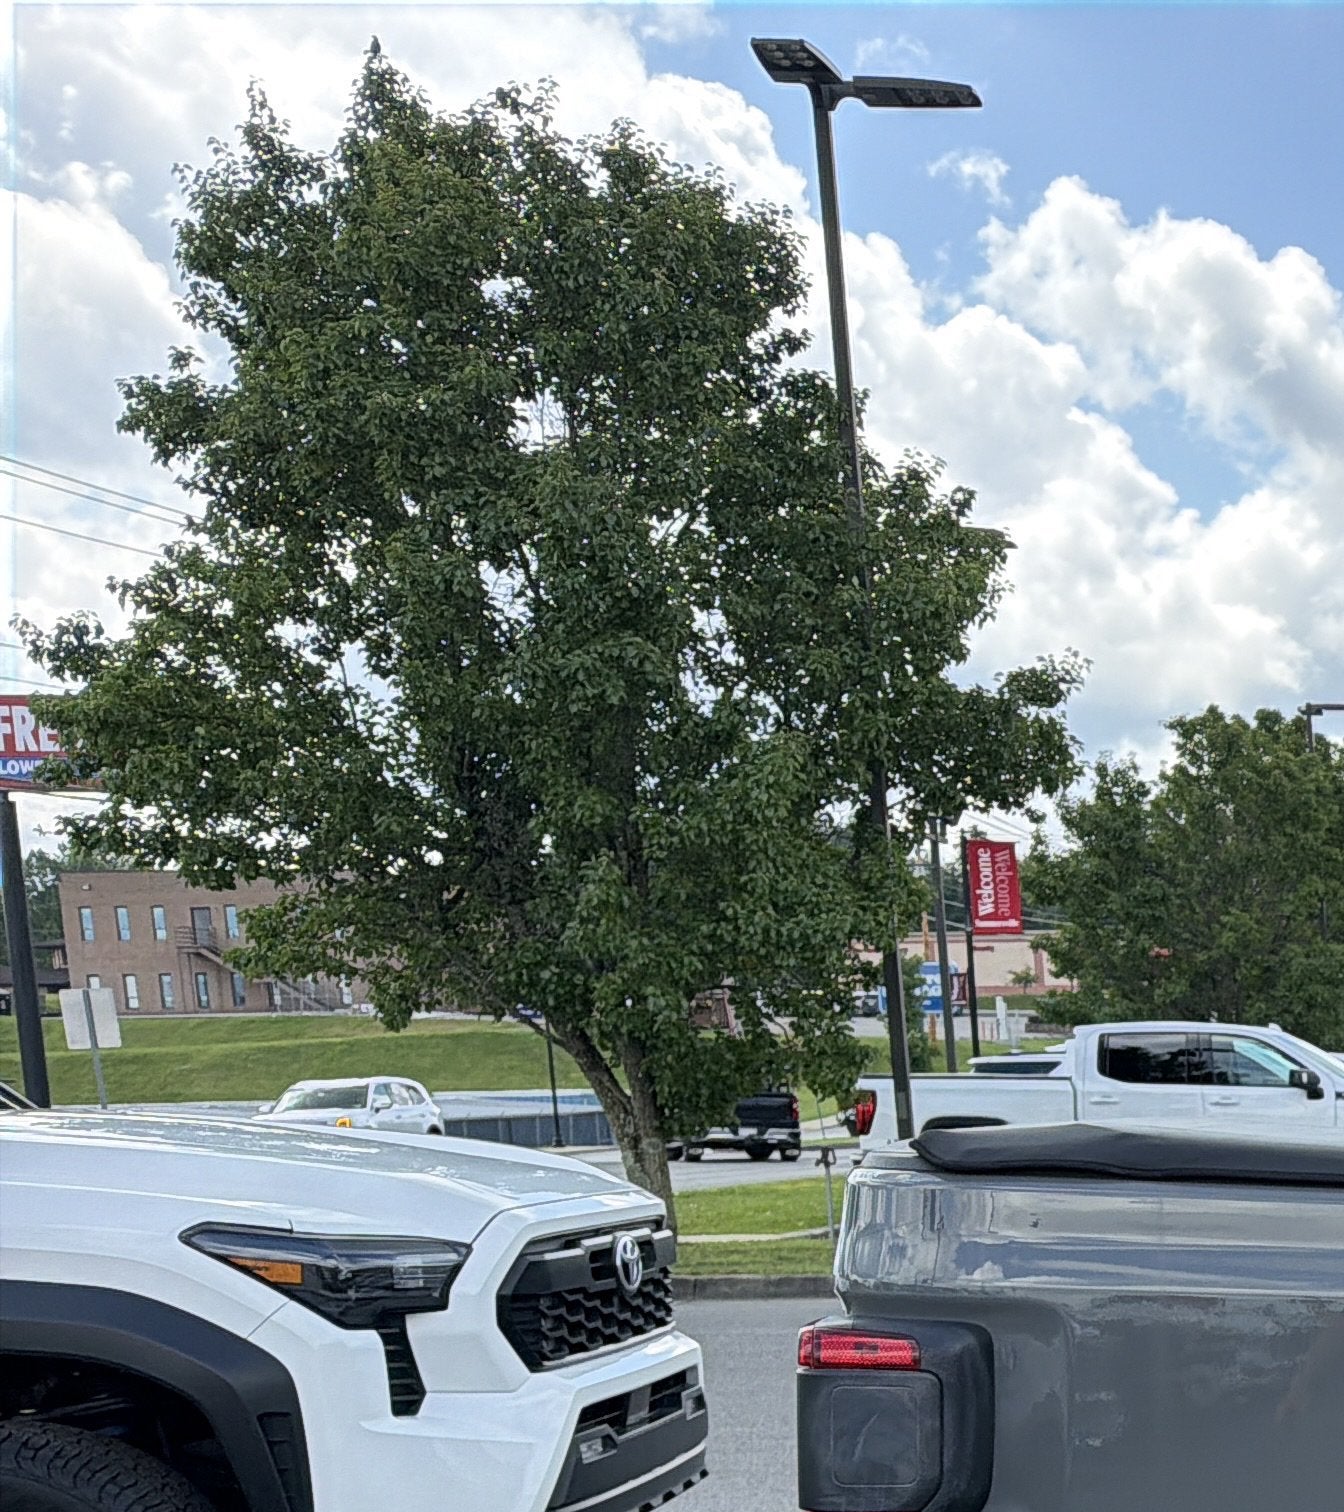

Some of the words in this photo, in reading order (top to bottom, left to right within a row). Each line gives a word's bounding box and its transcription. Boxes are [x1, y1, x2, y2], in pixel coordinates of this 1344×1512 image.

[0, 704, 64, 752] FRE
[0, 760, 43, 775] LOW
[975, 847, 996, 917] Welcome
[994, 848, 1013, 917] Welcome
